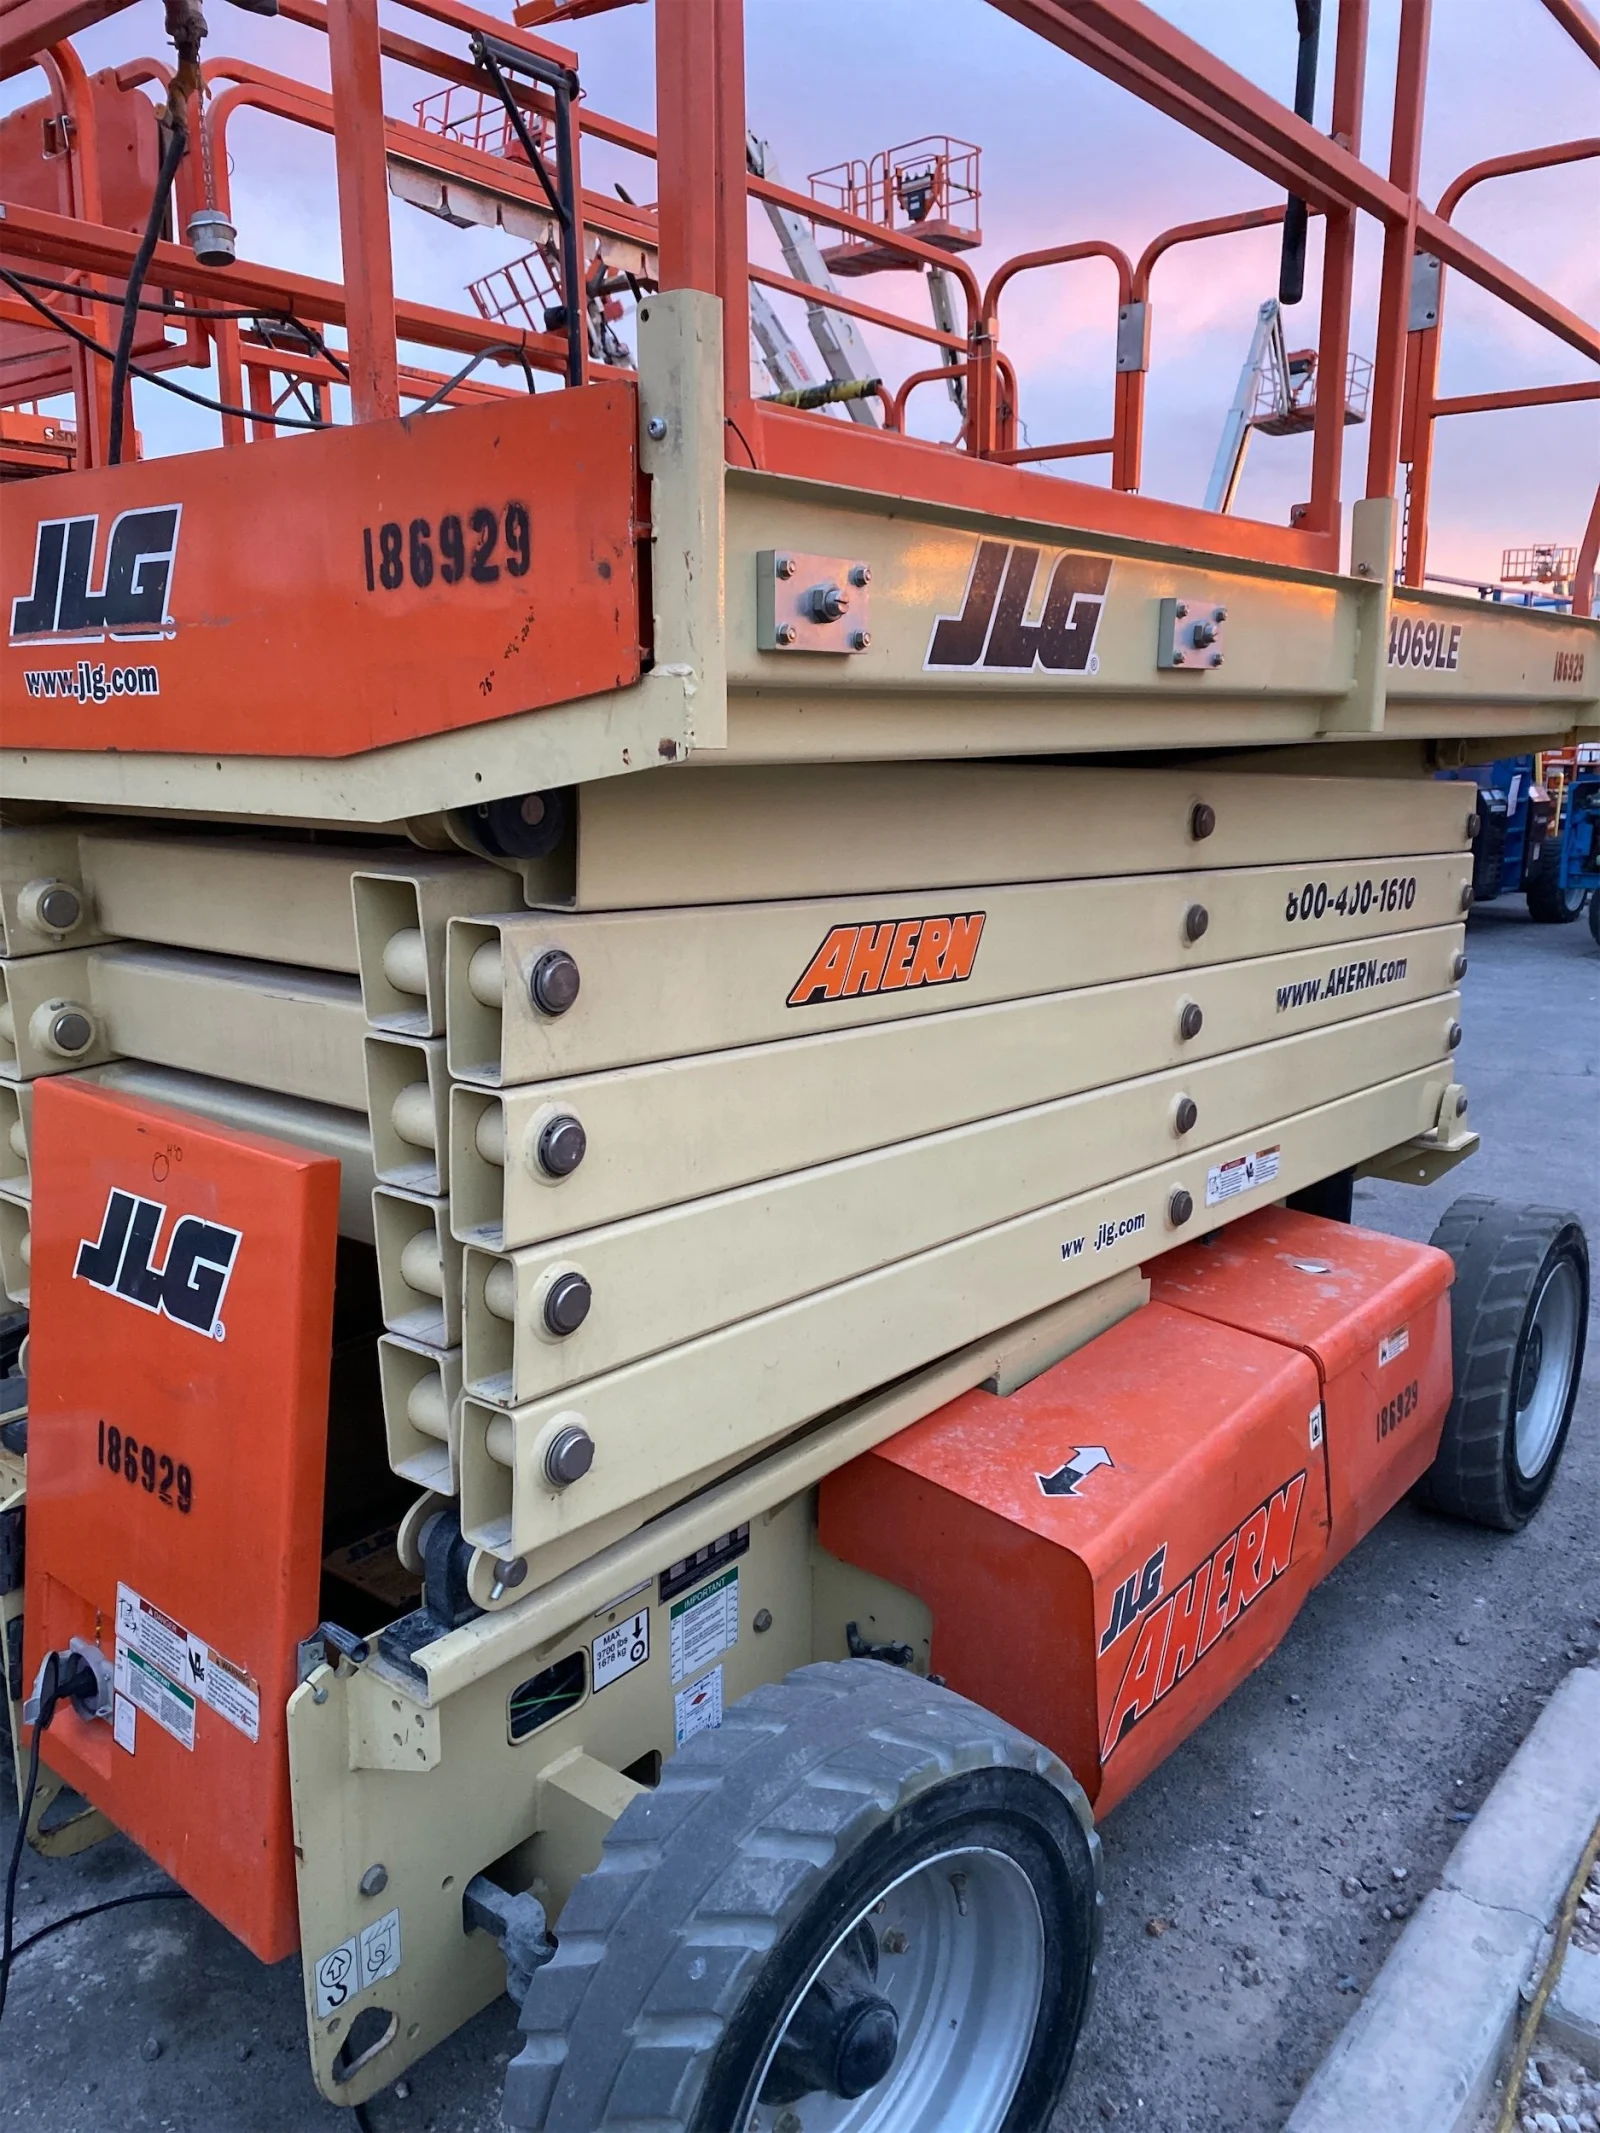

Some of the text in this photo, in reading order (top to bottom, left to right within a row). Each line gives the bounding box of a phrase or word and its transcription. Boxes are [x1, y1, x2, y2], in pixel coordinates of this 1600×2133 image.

[363, 503, 530, 591] 186929
[25, 661, 159, 704] www.jlg.com
[1553, 651, 1585, 683] 186929
[787, 911, 986, 1007] AHERN
[1276, 957, 1408, 1014] www.AHERN.com
[1376, 1379, 1419, 1443] 186929
[98, 1419, 192, 1514] 186929
[684, 1576, 726, 1609] IMPORTANT
[153, 1608, 178, 1633] DANGER
[1100, 1468, 1307, 1764] AHERN
[597, 1636, 628, 1661] 3700 lbs
[603, 1629, 621, 1646] MAX
[617, 1647, 627, 1658] kg
[142, 1662, 171, 1689] IMPORTANT
